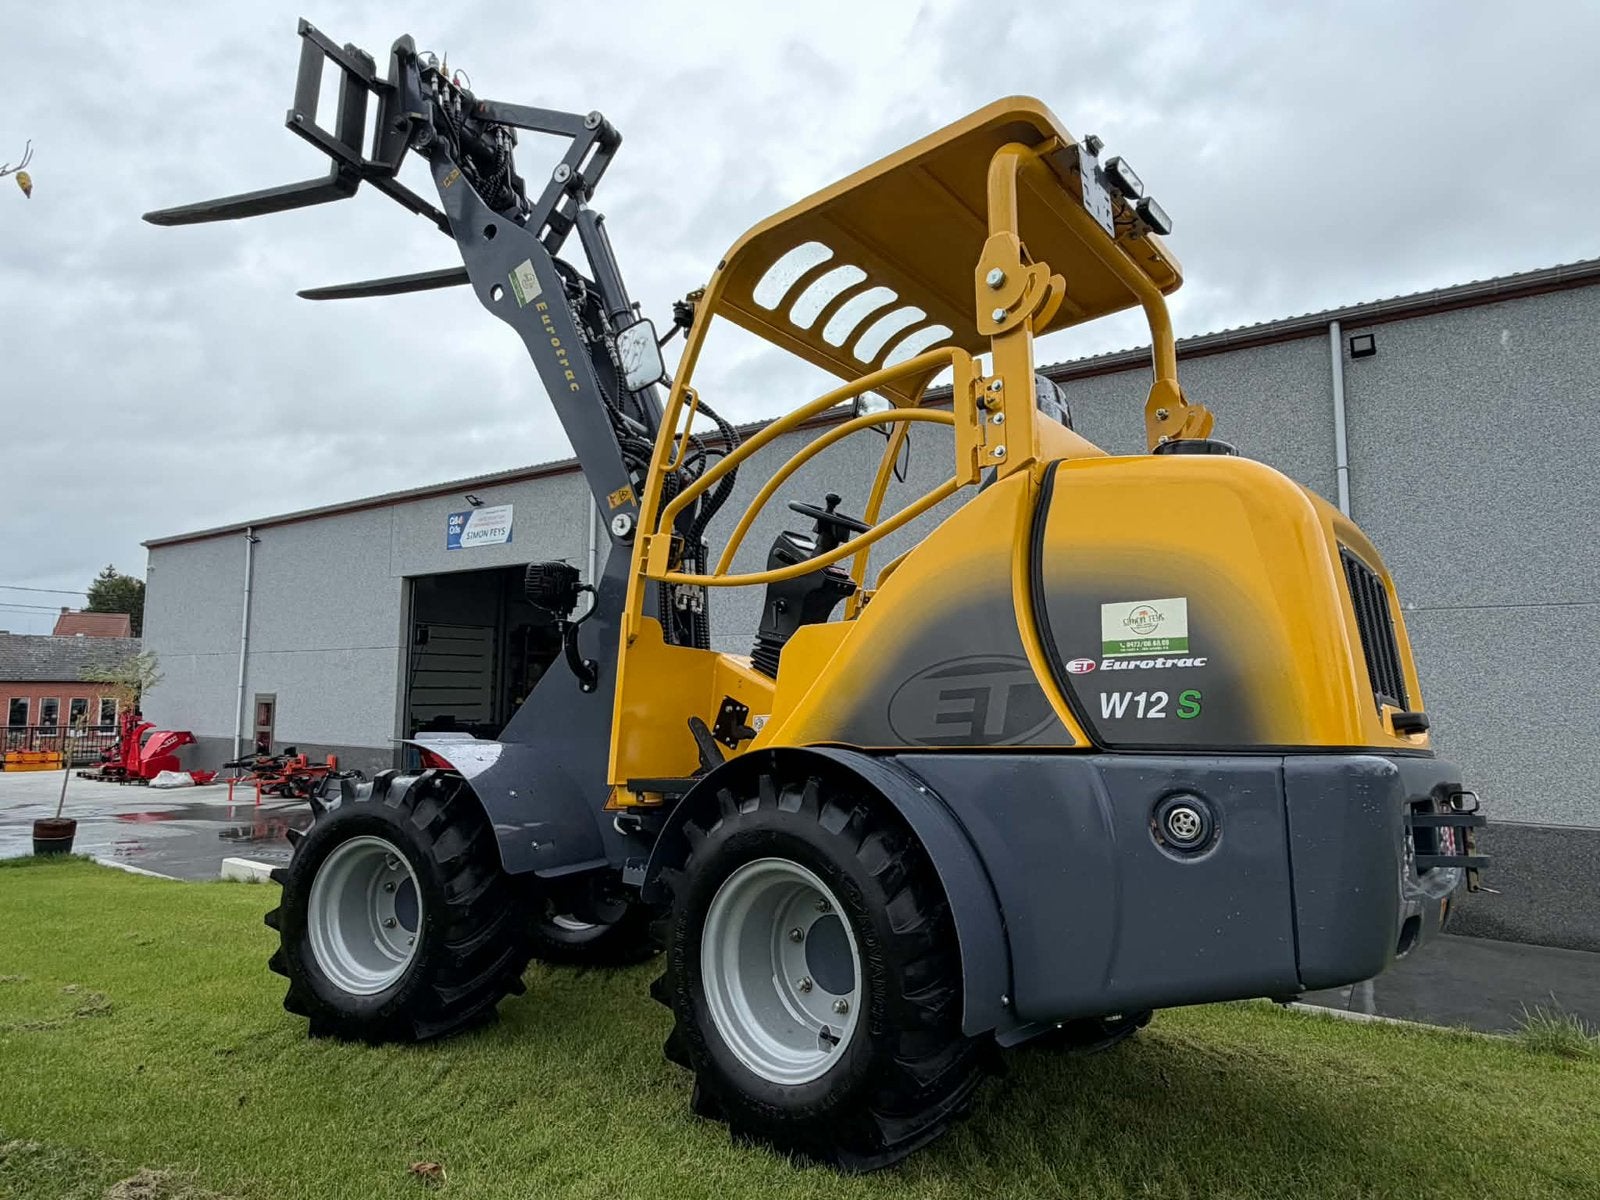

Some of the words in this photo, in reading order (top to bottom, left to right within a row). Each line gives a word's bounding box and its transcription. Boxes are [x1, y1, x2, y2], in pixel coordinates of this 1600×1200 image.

[535, 301, 580, 392] Eurotrac
[1100, 657, 1207, 671] Eurotrac
[1100, 691, 1169, 719] W12
[1176, 689, 1202, 720] S
